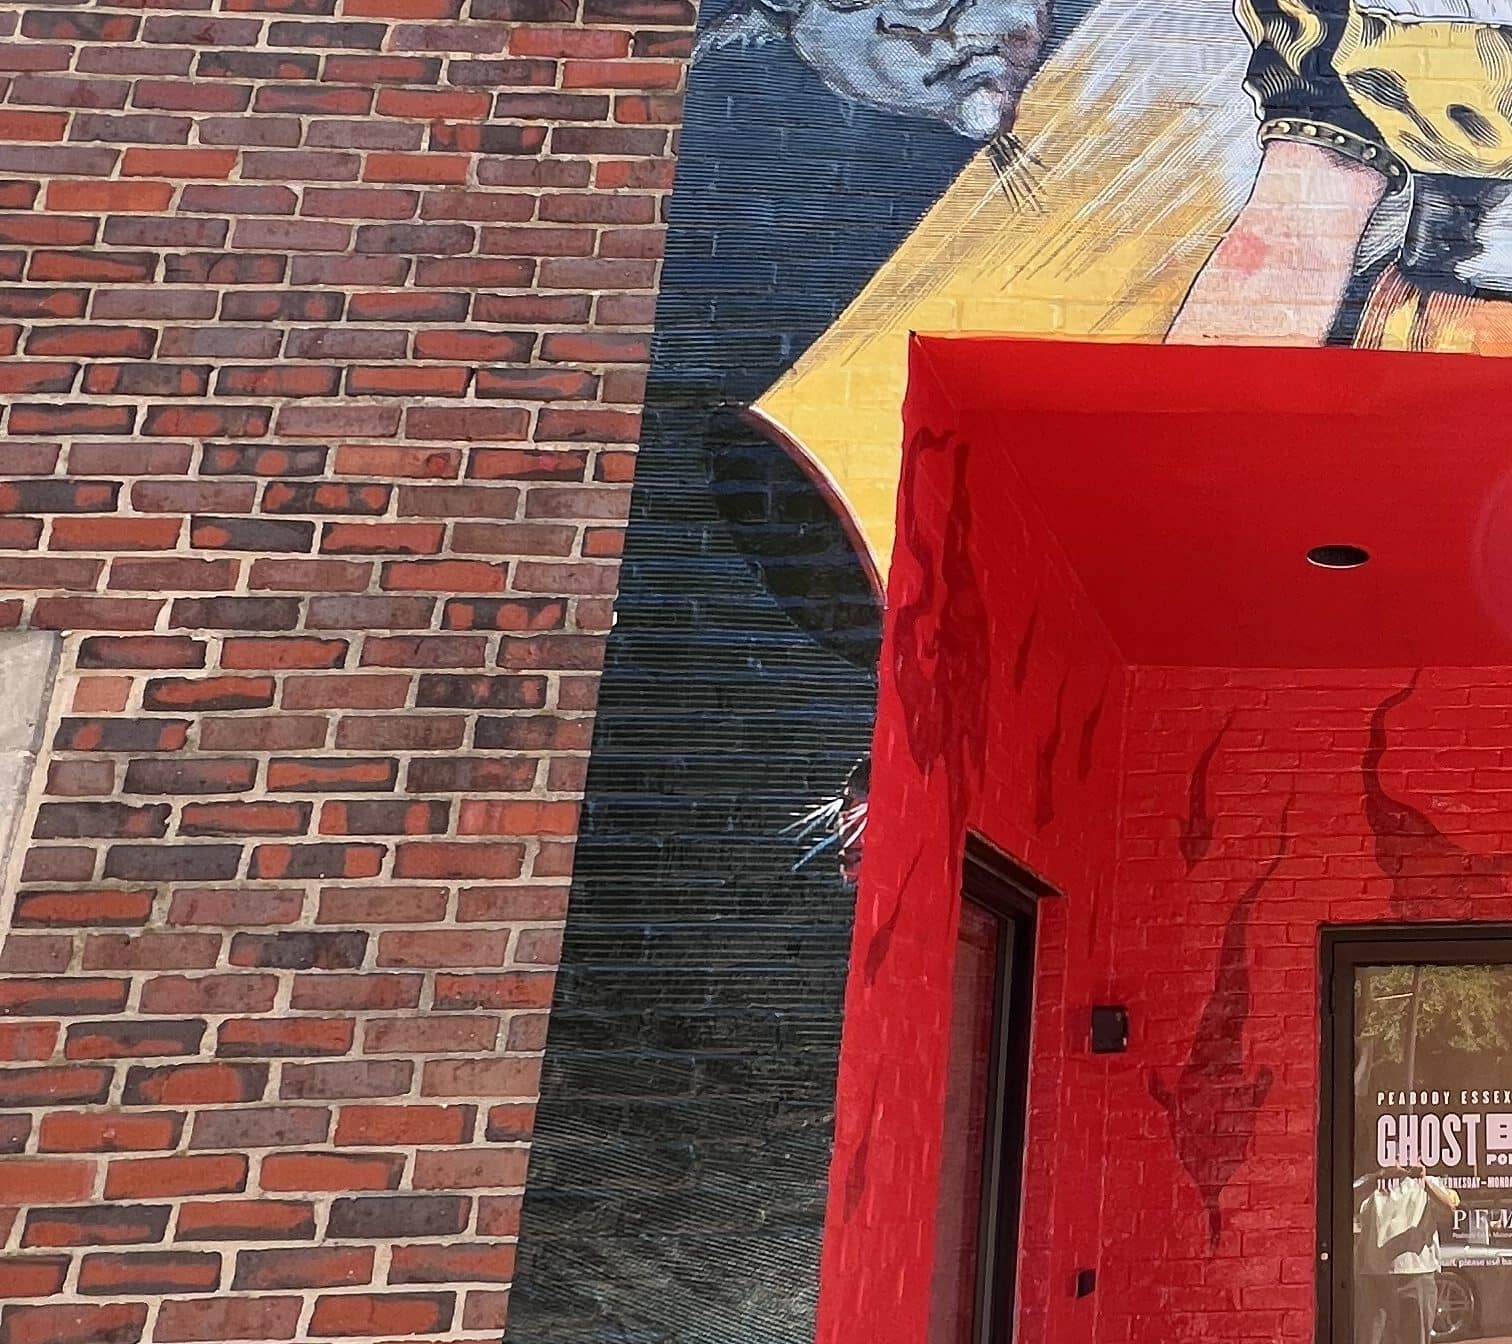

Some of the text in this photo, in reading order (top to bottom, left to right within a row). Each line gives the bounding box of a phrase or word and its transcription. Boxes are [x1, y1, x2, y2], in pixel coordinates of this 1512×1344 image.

[1377, 1090, 1450, 1106] PEABODY
[1461, 1089, 1512, 1105] ESSEX
[1377, 1112, 1481, 1168] GHOST
[1458, 1257, 1485, 1268] please
